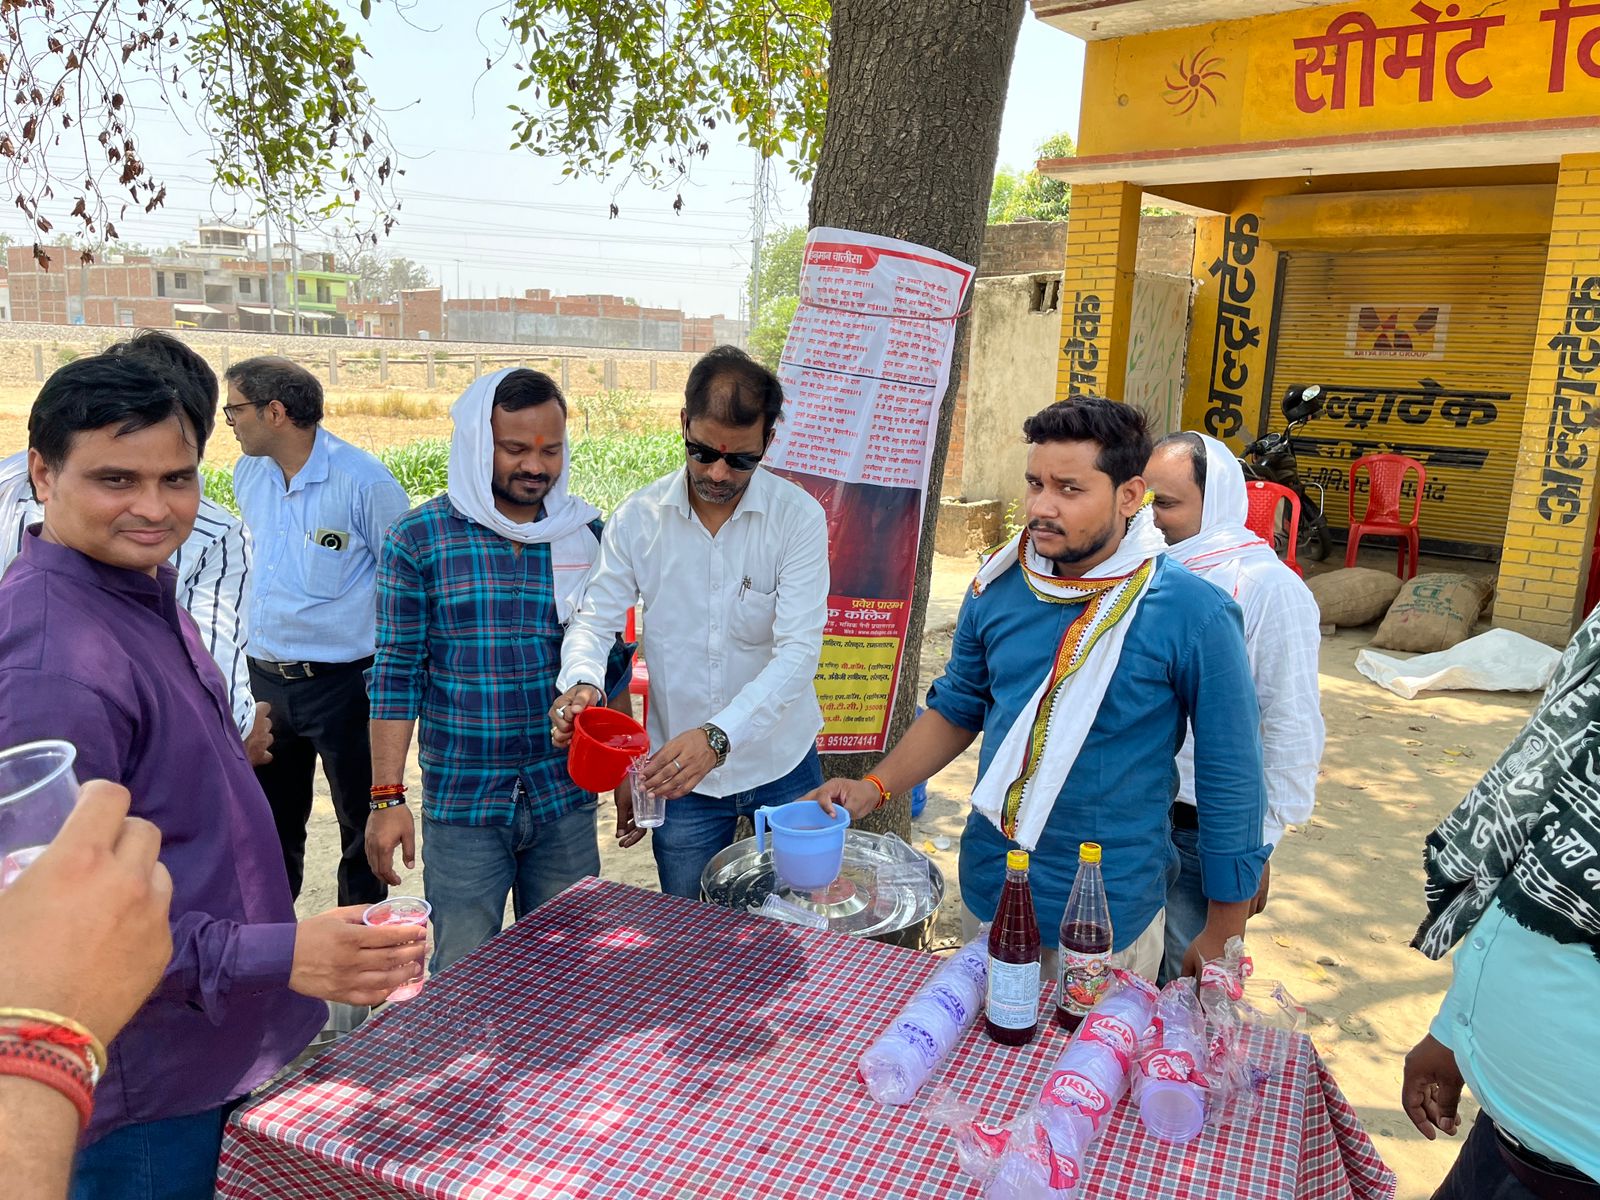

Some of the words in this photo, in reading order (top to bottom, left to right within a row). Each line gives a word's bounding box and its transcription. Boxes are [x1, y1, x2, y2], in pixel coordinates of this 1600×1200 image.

[1293, 0, 1505, 114] सीमेंट
[832, 250, 863, 265] चालीसा
[1318, 377, 1512, 430] ल्ट्राटेक
[844, 608, 892, 621] कॉलेज
[828, 735, 877, 747] 9519274141
